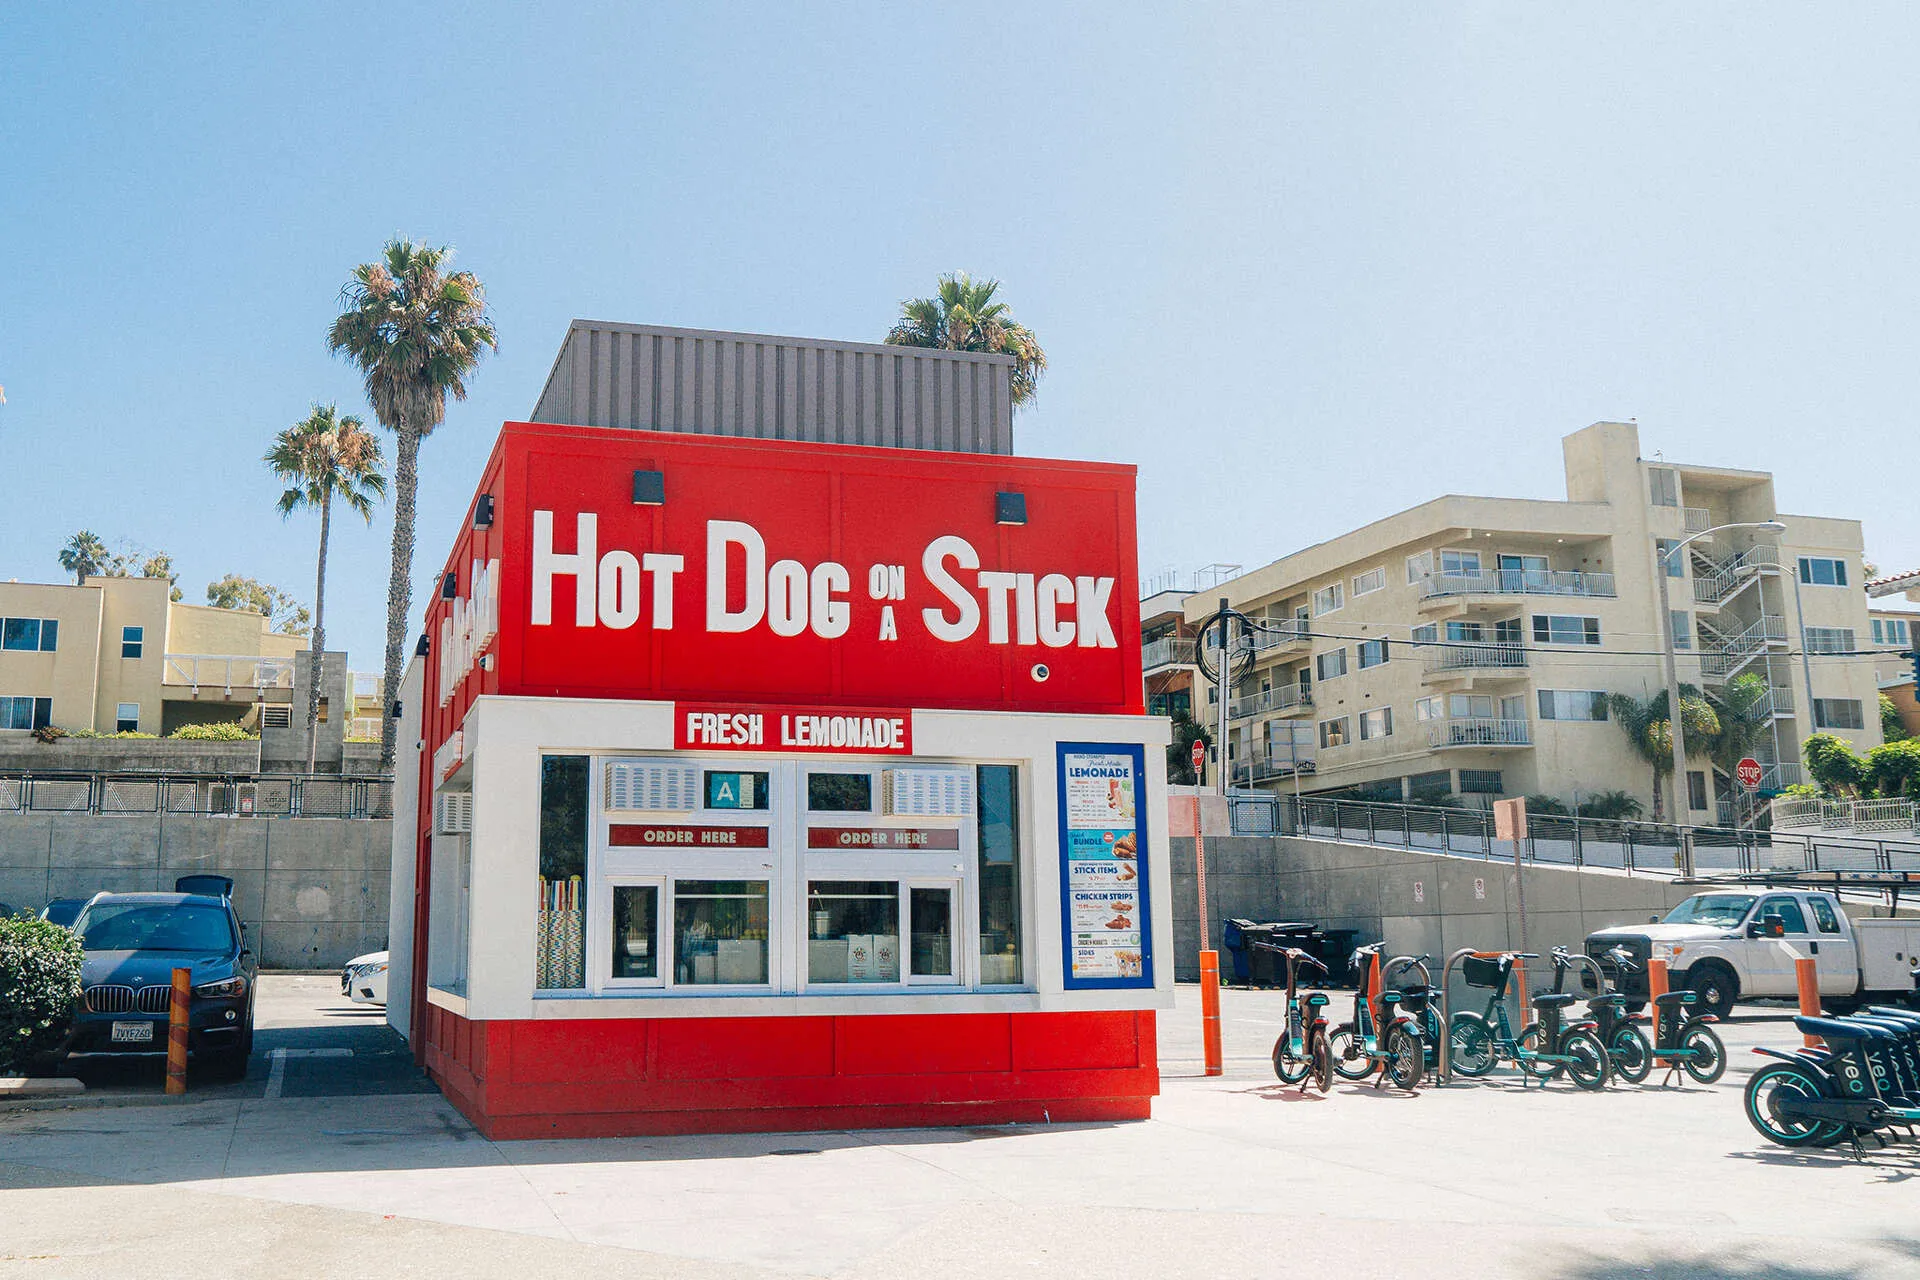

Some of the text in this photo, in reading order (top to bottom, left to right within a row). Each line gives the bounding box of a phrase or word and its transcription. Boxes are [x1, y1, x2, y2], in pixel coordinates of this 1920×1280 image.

[531, 510, 1118, 649] HOT DOG ON A STICK
[686, 713, 904, 749] FRESH LEMONADE
[1192, 747, 1204, 759] STOP
[1069, 768, 1129, 778] LEMONADE
[1738, 766, 1760, 778] STOP
[717, 781, 735, 801] A
[643, 830, 737, 844] ORDER HERE
[840, 830, 928, 846] ORDER HERE
[1073, 838, 1102, 846] BUNDLE
[1074, 866, 1096, 874] STICK
[1075, 893, 1133, 901] CHICKEN STRIPS
[1539, 1018, 1547, 1045] veo
[1841, 1052, 1864, 1093] veo
[1869, 1051, 1890, 1091] veo
